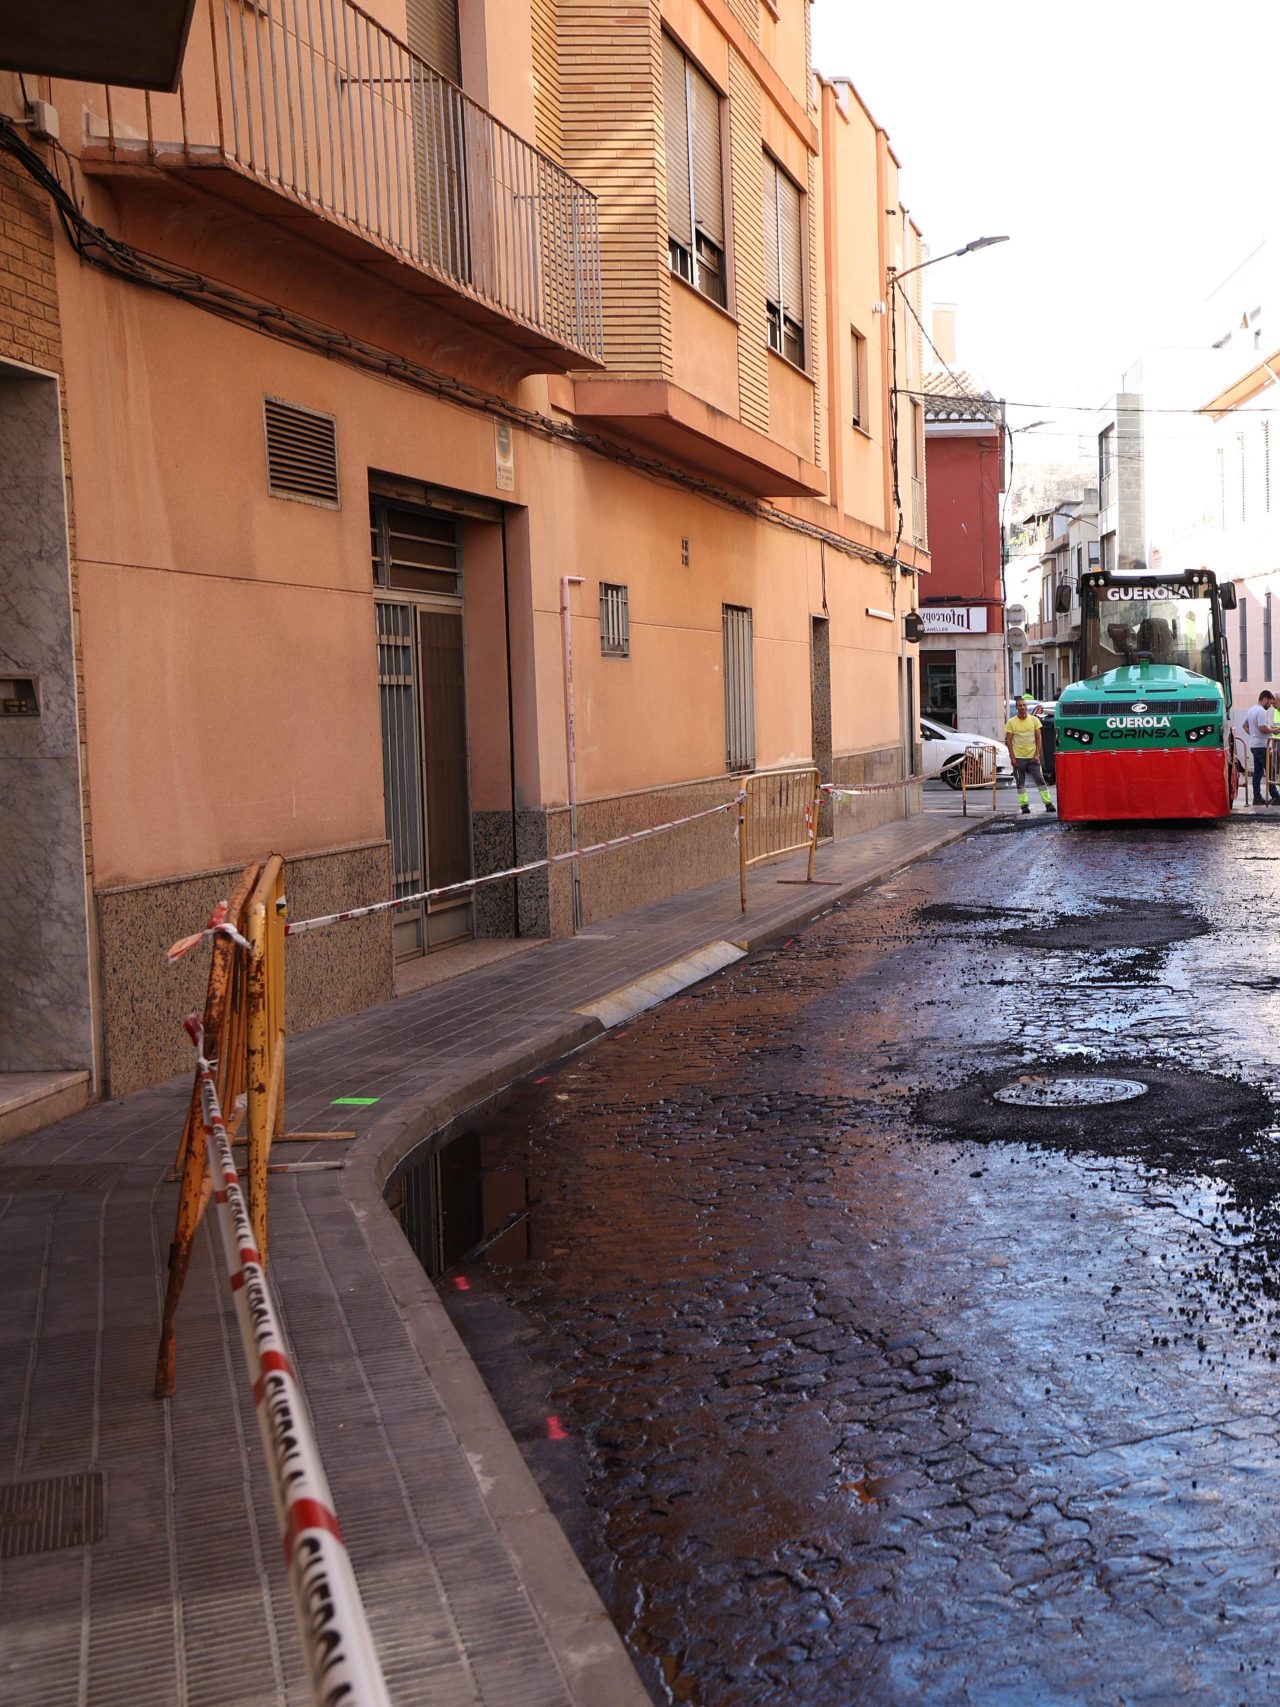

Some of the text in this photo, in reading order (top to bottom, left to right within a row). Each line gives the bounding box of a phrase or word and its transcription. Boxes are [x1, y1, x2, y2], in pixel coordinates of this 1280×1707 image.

[1107, 585, 1191, 601] GUEROLA
[1106, 716, 1171, 728] GUEROLA
[1099, 728, 1181, 739] CORINSA
